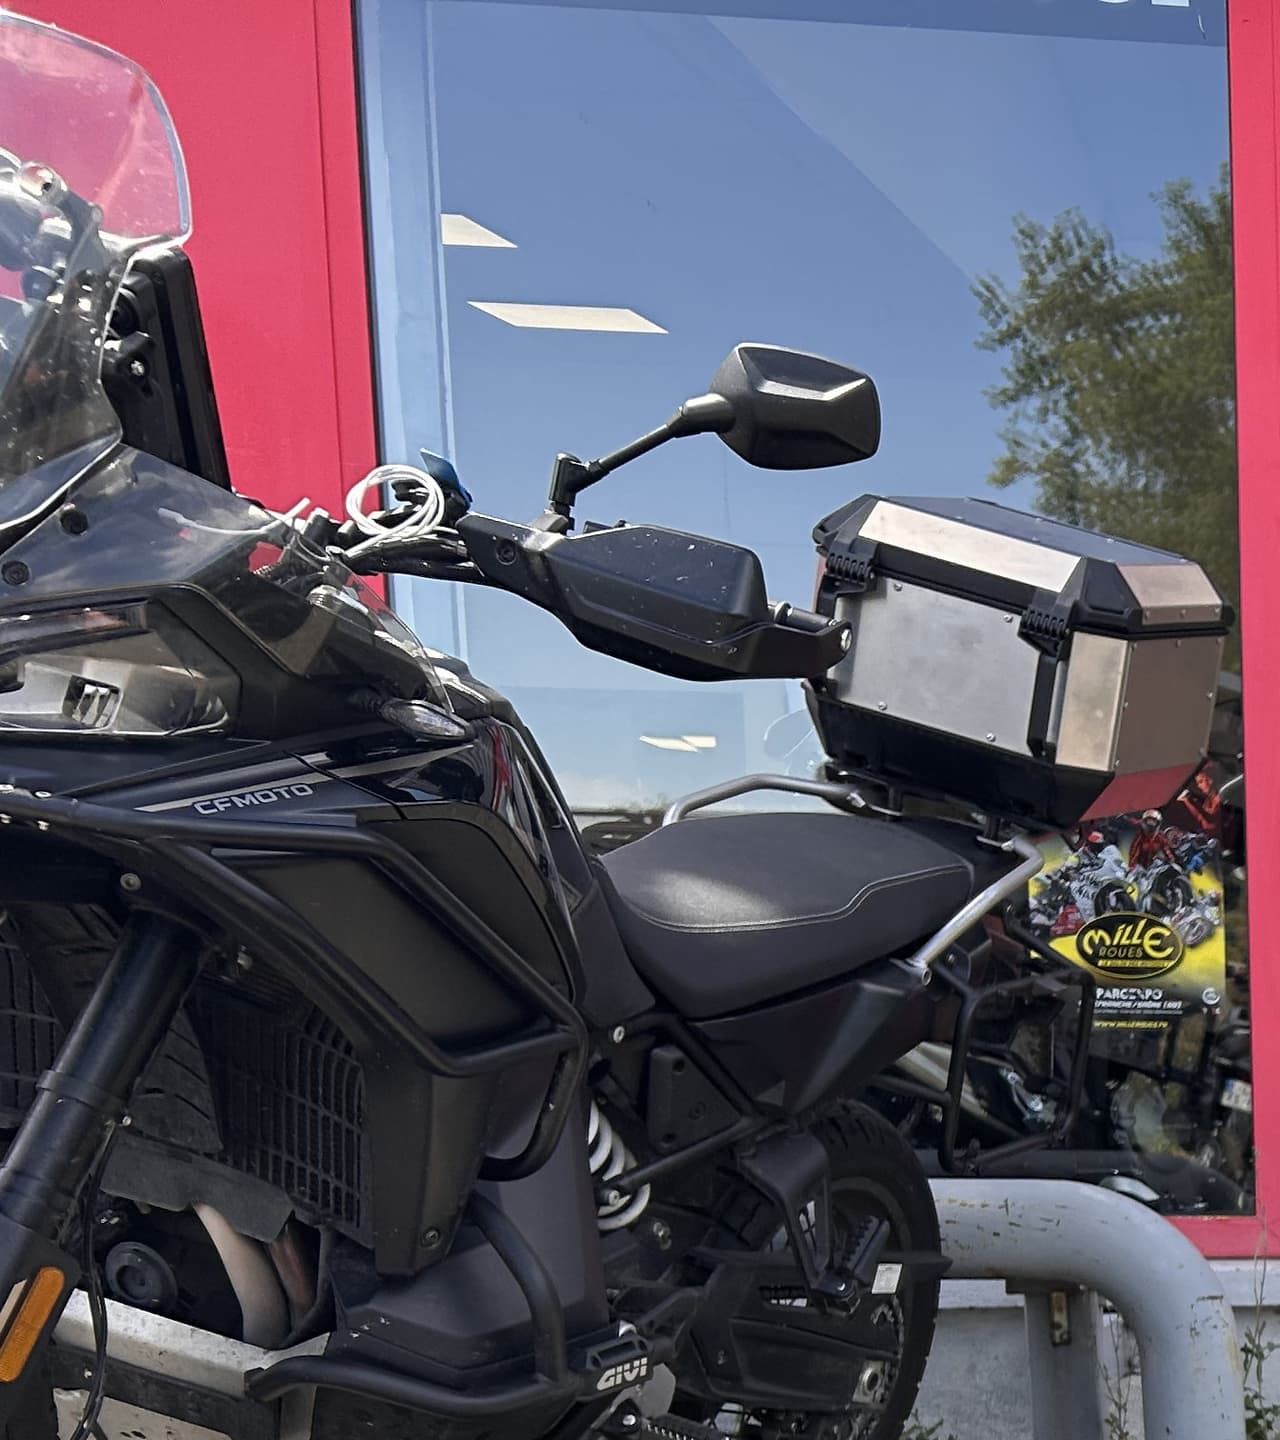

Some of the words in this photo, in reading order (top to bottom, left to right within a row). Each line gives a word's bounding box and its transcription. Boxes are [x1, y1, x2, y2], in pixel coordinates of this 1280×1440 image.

[194, 784, 314, 814] CFMOTO
[1099, 947, 1143, 958] ROUES
[597, 1357, 648, 1391] GIVI
